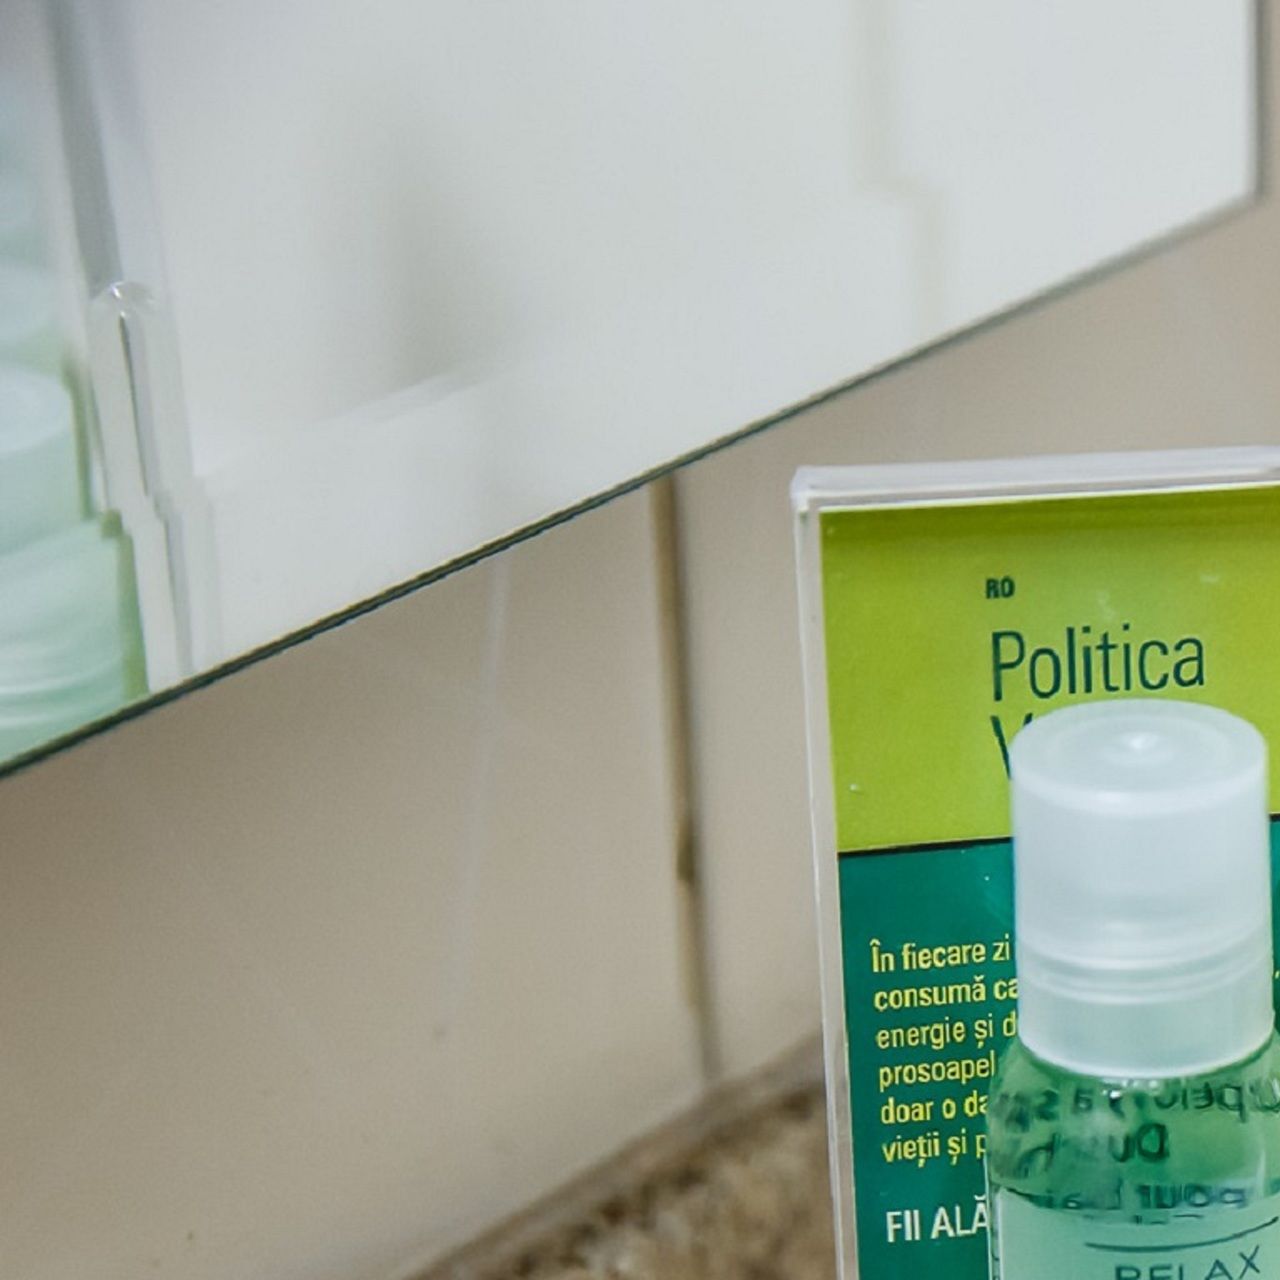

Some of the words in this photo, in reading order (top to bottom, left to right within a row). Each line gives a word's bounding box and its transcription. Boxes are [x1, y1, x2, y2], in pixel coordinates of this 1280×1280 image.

[986, 576, 1015, 599] RO
[991, 623, 1206, 703] Politica
[870, 938, 895, 973] În
[902, 942, 986, 971] fiecare
[992, 933, 1010, 961] zi
[874, 974, 987, 1011] consumă
[876, 1016, 966, 1050] energie
[881, 1097, 934, 1125] doar
[942, 1098, 956, 1119] o
[886, 1208, 921, 1243] FII
